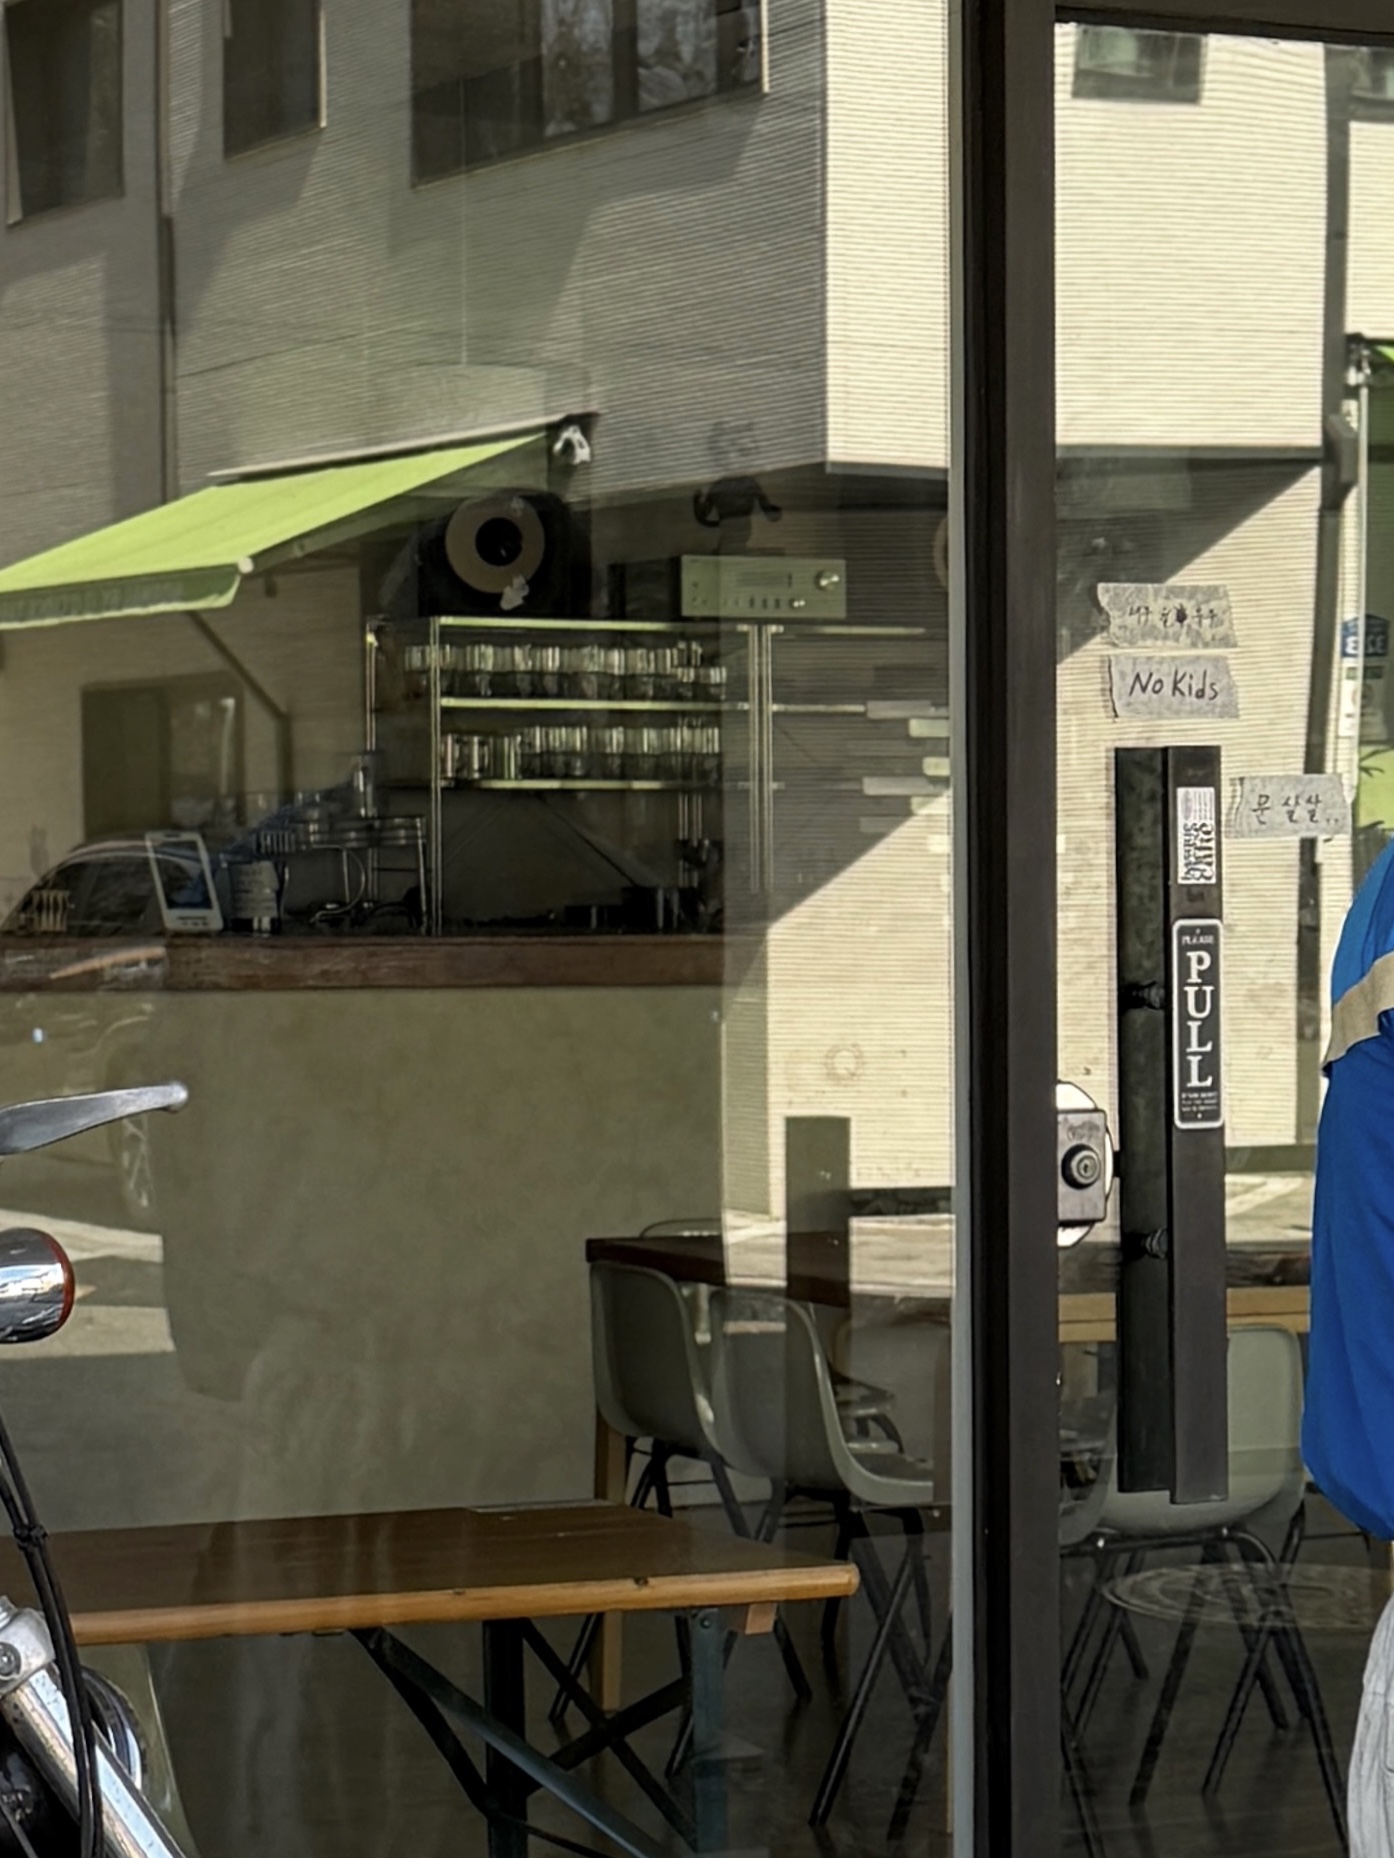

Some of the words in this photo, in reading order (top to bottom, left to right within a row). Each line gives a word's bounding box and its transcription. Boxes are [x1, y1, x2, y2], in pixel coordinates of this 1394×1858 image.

[1129, 672, 1164, 697] No
[1171, 668, 1219, 701] Kids
[1251, 793, 1271, 825] 문
[1183, 950, 1215, 1088] PULL
